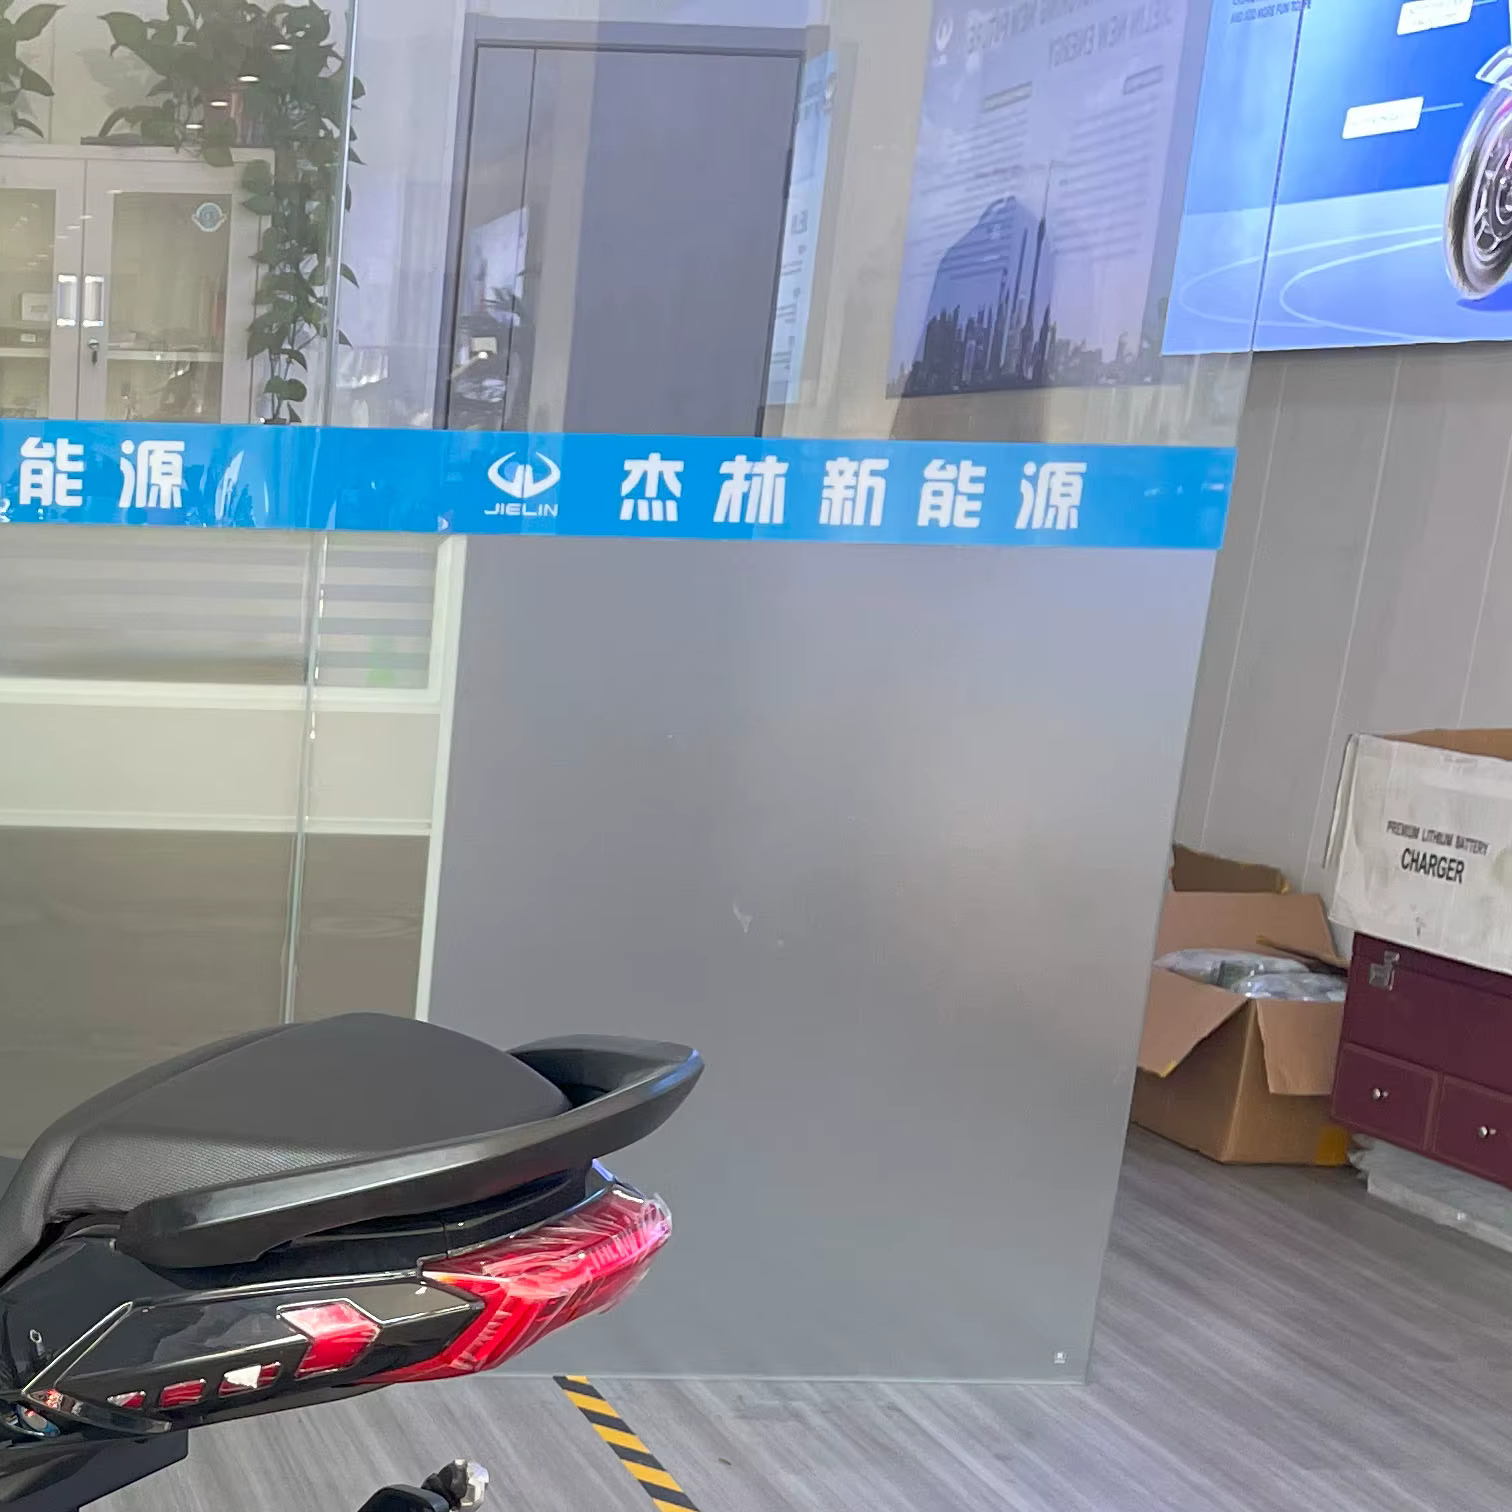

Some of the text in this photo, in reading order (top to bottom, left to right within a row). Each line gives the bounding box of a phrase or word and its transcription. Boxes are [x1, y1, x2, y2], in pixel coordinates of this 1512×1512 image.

[619, 452, 1088, 530] 杰林新能源
[484, 503, 558, 518] JIELIN
[1386, 820, 1489, 856] PREMIUM LITHIUM BATTERY
[1401, 847, 1465, 884] CHARGER
